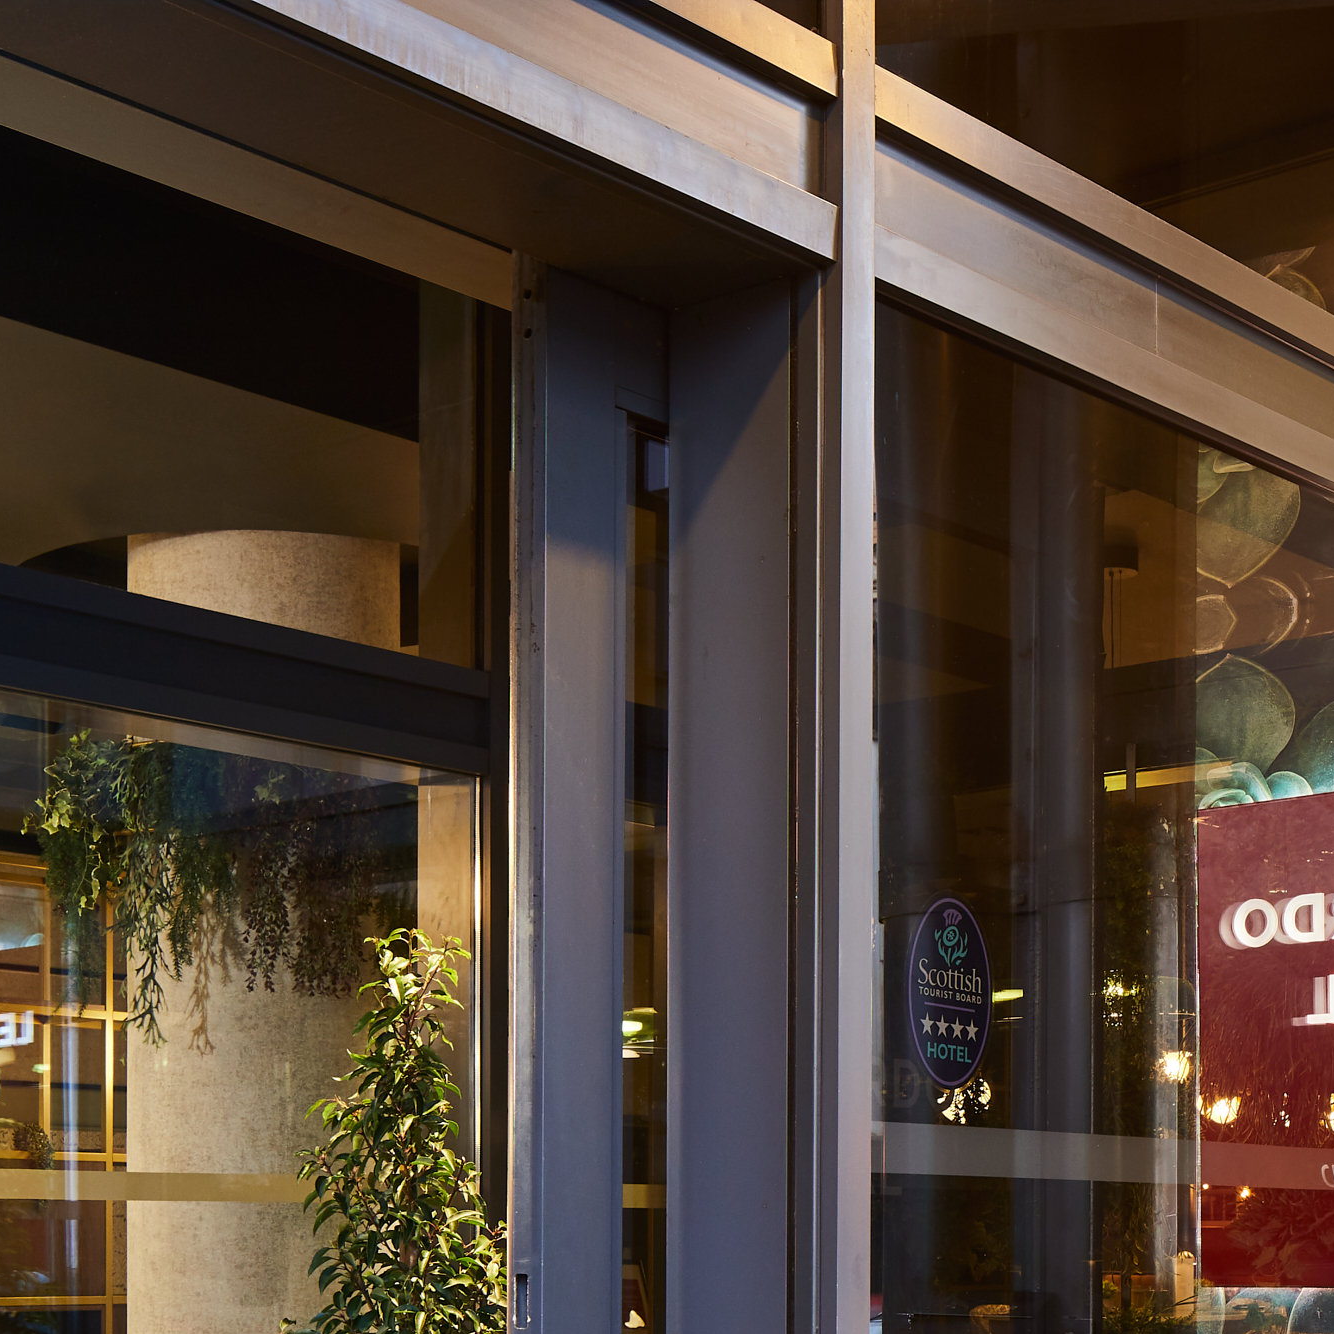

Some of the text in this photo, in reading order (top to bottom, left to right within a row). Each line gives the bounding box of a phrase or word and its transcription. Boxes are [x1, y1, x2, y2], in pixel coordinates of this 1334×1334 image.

[918, 957, 983, 994] Scottish
[918, 985, 982, 1005] TOURIST BOARD
[927, 1040, 972, 1063] HOTEL
